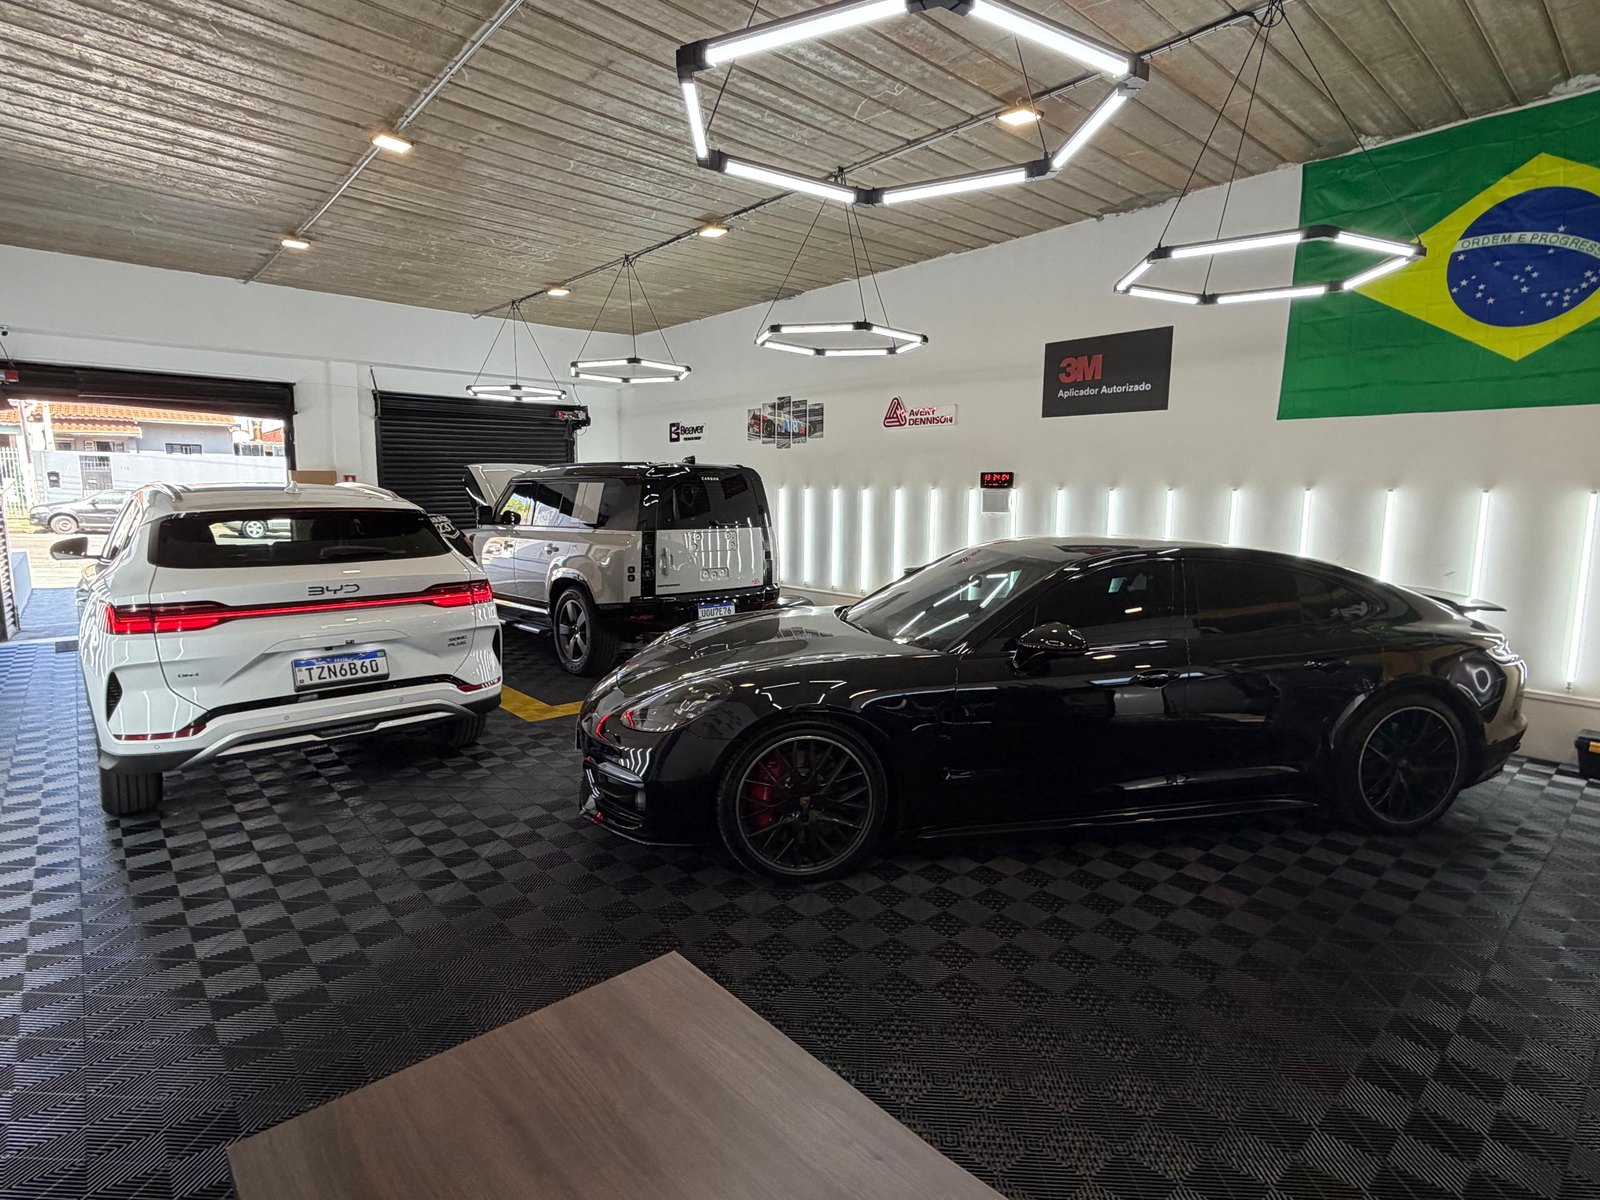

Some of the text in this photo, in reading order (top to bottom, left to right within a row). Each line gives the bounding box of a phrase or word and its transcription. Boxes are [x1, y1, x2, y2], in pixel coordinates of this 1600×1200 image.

[1461, 234, 1512, 249] ORDEM
[1517, 233, 1527, 243] E
[1059, 354, 1103, 384] 3M
[1057, 381, 1152, 400] Aplicador Autorizado
[908, 406, 936, 417] AVERY
[908, 415, 954, 426] DENNISON
[680, 425, 704, 435] Beaver
[308, 583, 360, 596] BYD
